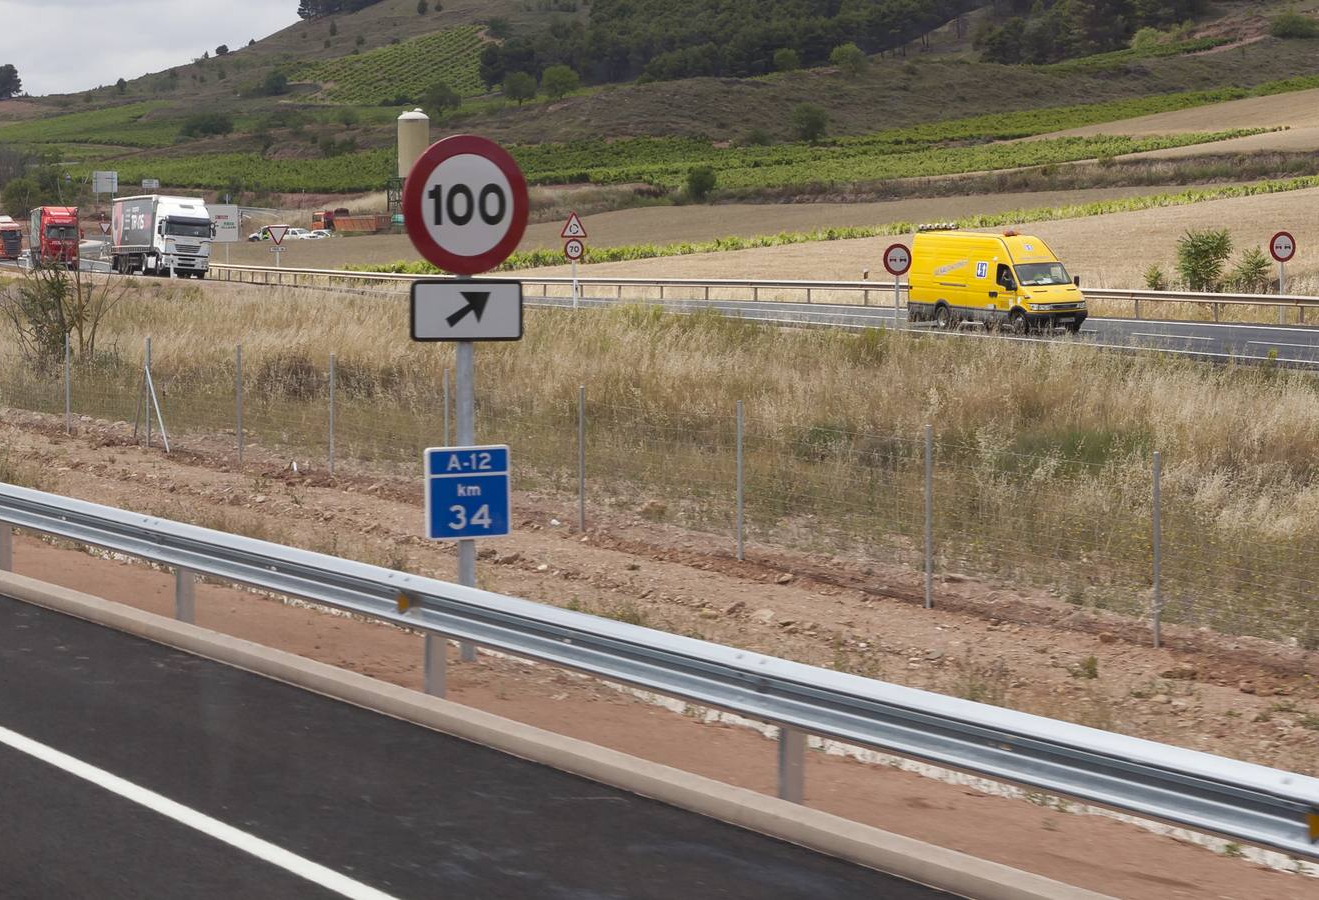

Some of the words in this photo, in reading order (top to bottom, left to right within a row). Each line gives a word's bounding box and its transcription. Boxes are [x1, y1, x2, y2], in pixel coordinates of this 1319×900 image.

[428, 183, 506, 226] 100
[569, 245, 580, 253] 70
[446, 452, 492, 471] A-12
[456, 483, 481, 497] km
[448, 503, 493, 530] 34
